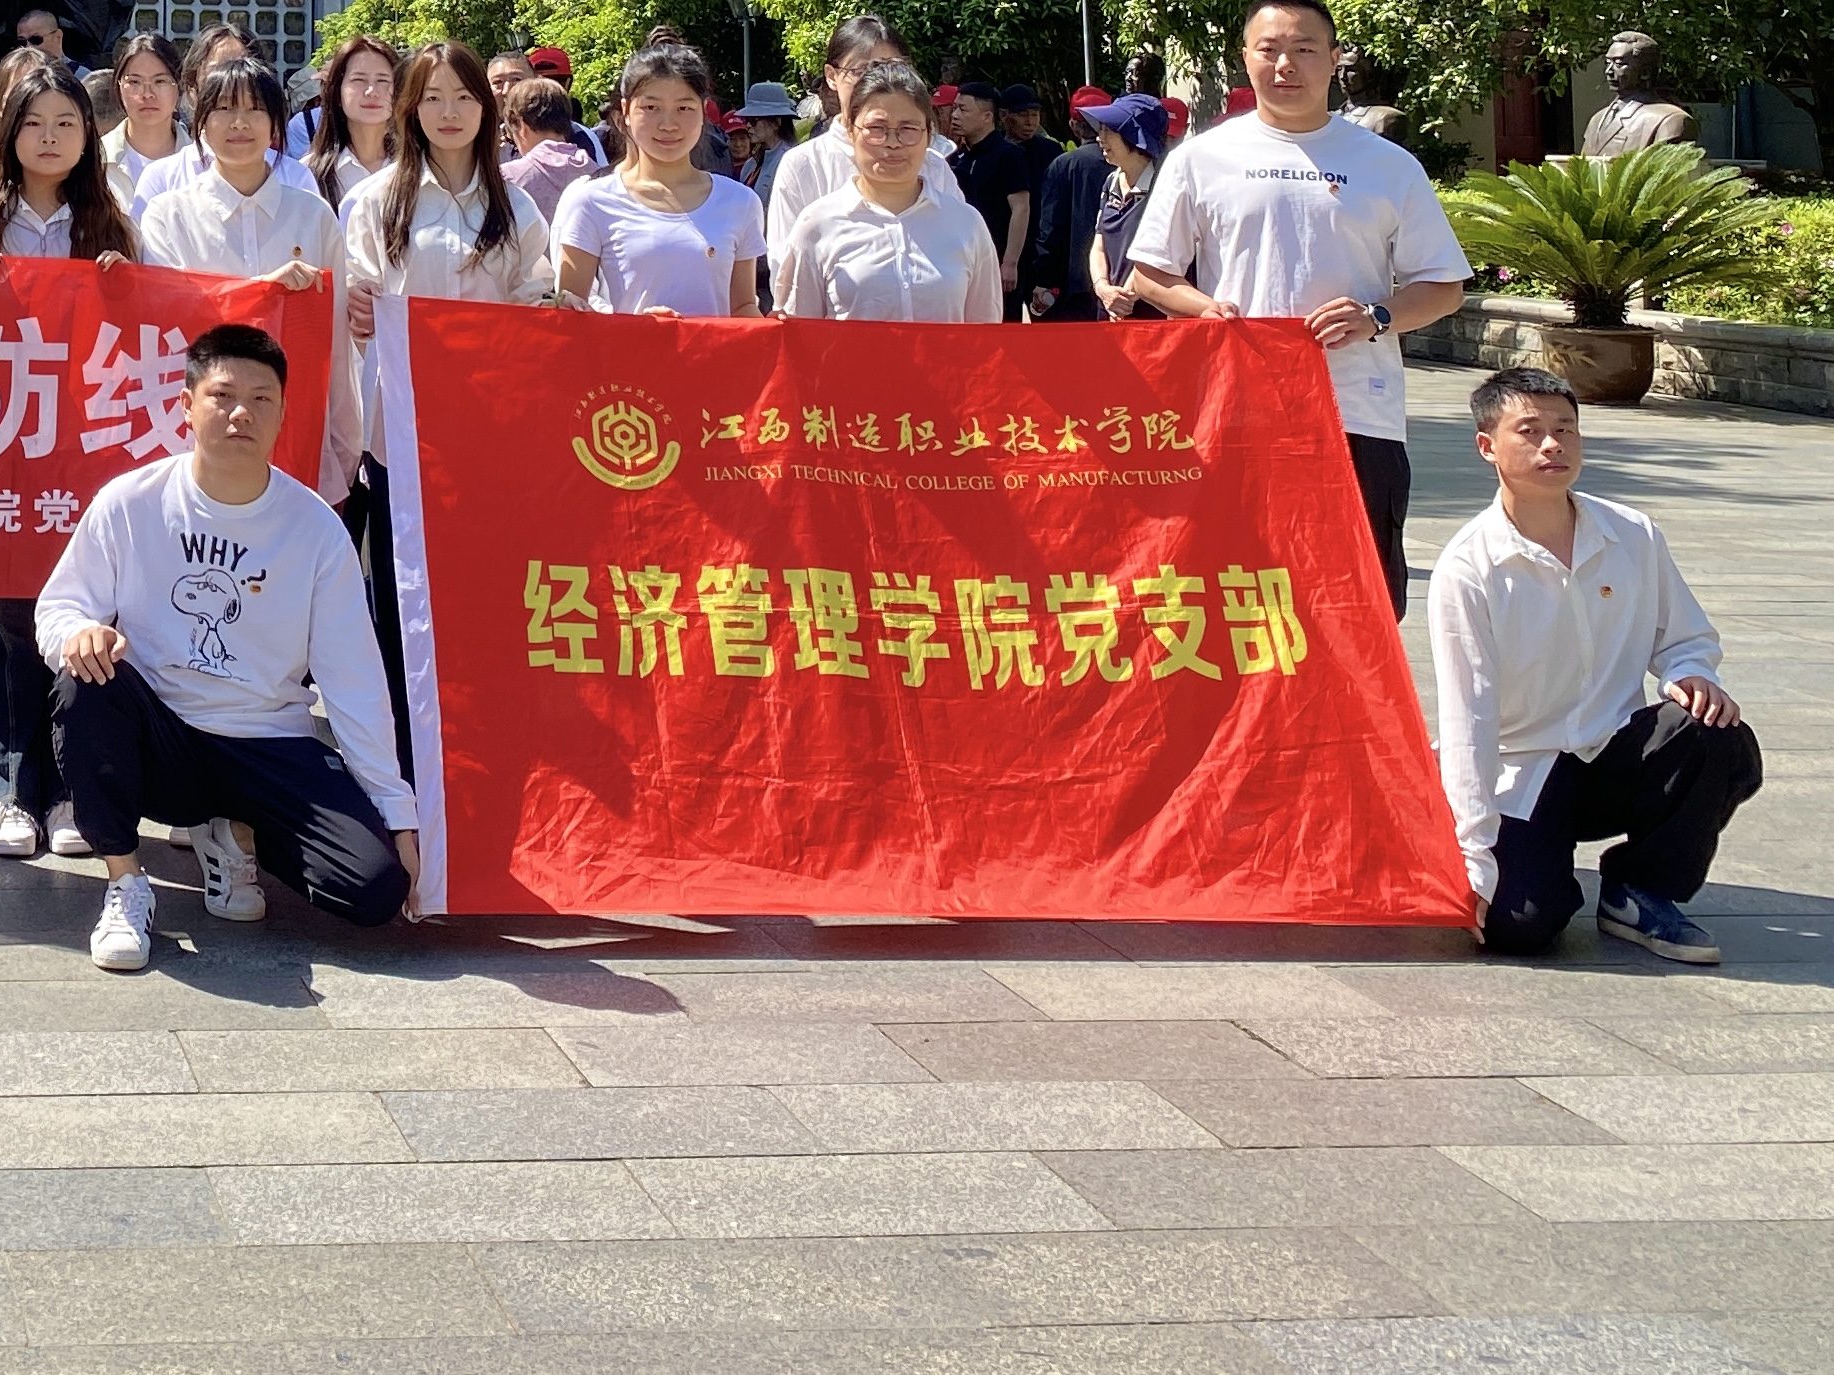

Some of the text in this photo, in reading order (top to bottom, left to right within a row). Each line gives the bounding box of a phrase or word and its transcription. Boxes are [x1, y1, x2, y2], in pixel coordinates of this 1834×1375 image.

[1245, 168, 1348, 185] NORELIGION
[699, 404, 1196, 458] 江西制造职业技术学院
[704, 465, 783, 482] JIANGXI
[790, 464, 898, 490] TECHNICAL
[905, 474, 996, 491] COLLEGE
[1003, 472, 1030, 490] OF
[522, 558, 1308, 692] 经济管理学院党支部
